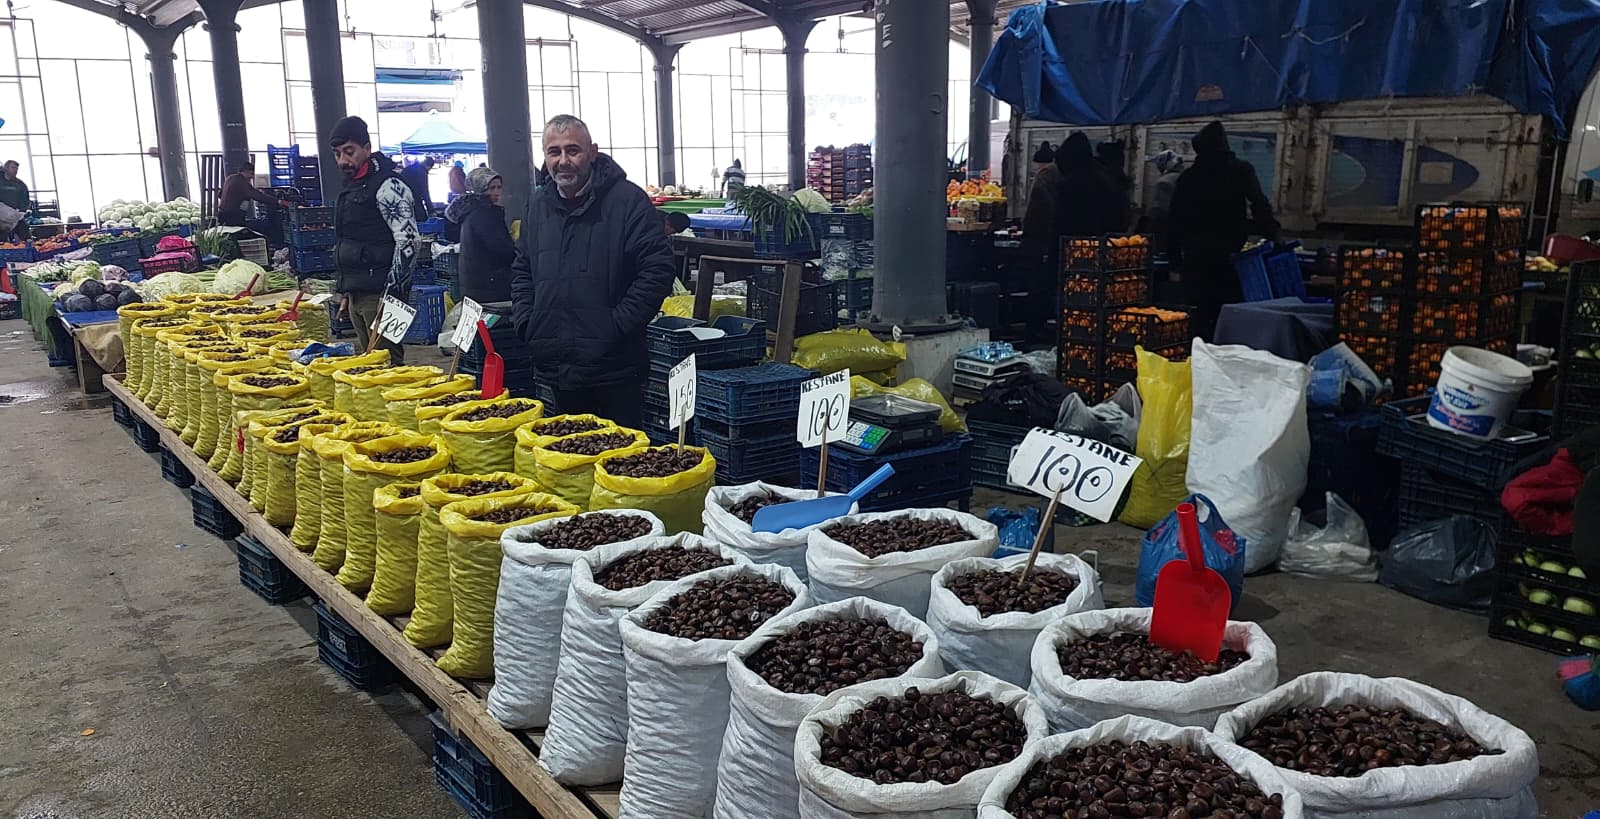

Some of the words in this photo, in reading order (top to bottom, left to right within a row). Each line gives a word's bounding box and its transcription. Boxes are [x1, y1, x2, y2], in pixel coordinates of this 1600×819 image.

[380, 312, 408, 338] 200
[674, 378, 694, 420] 150
[801, 370, 846, 394] KESTANE
[808, 392, 845, 441] 100
[1026, 445, 1114, 503] 100
